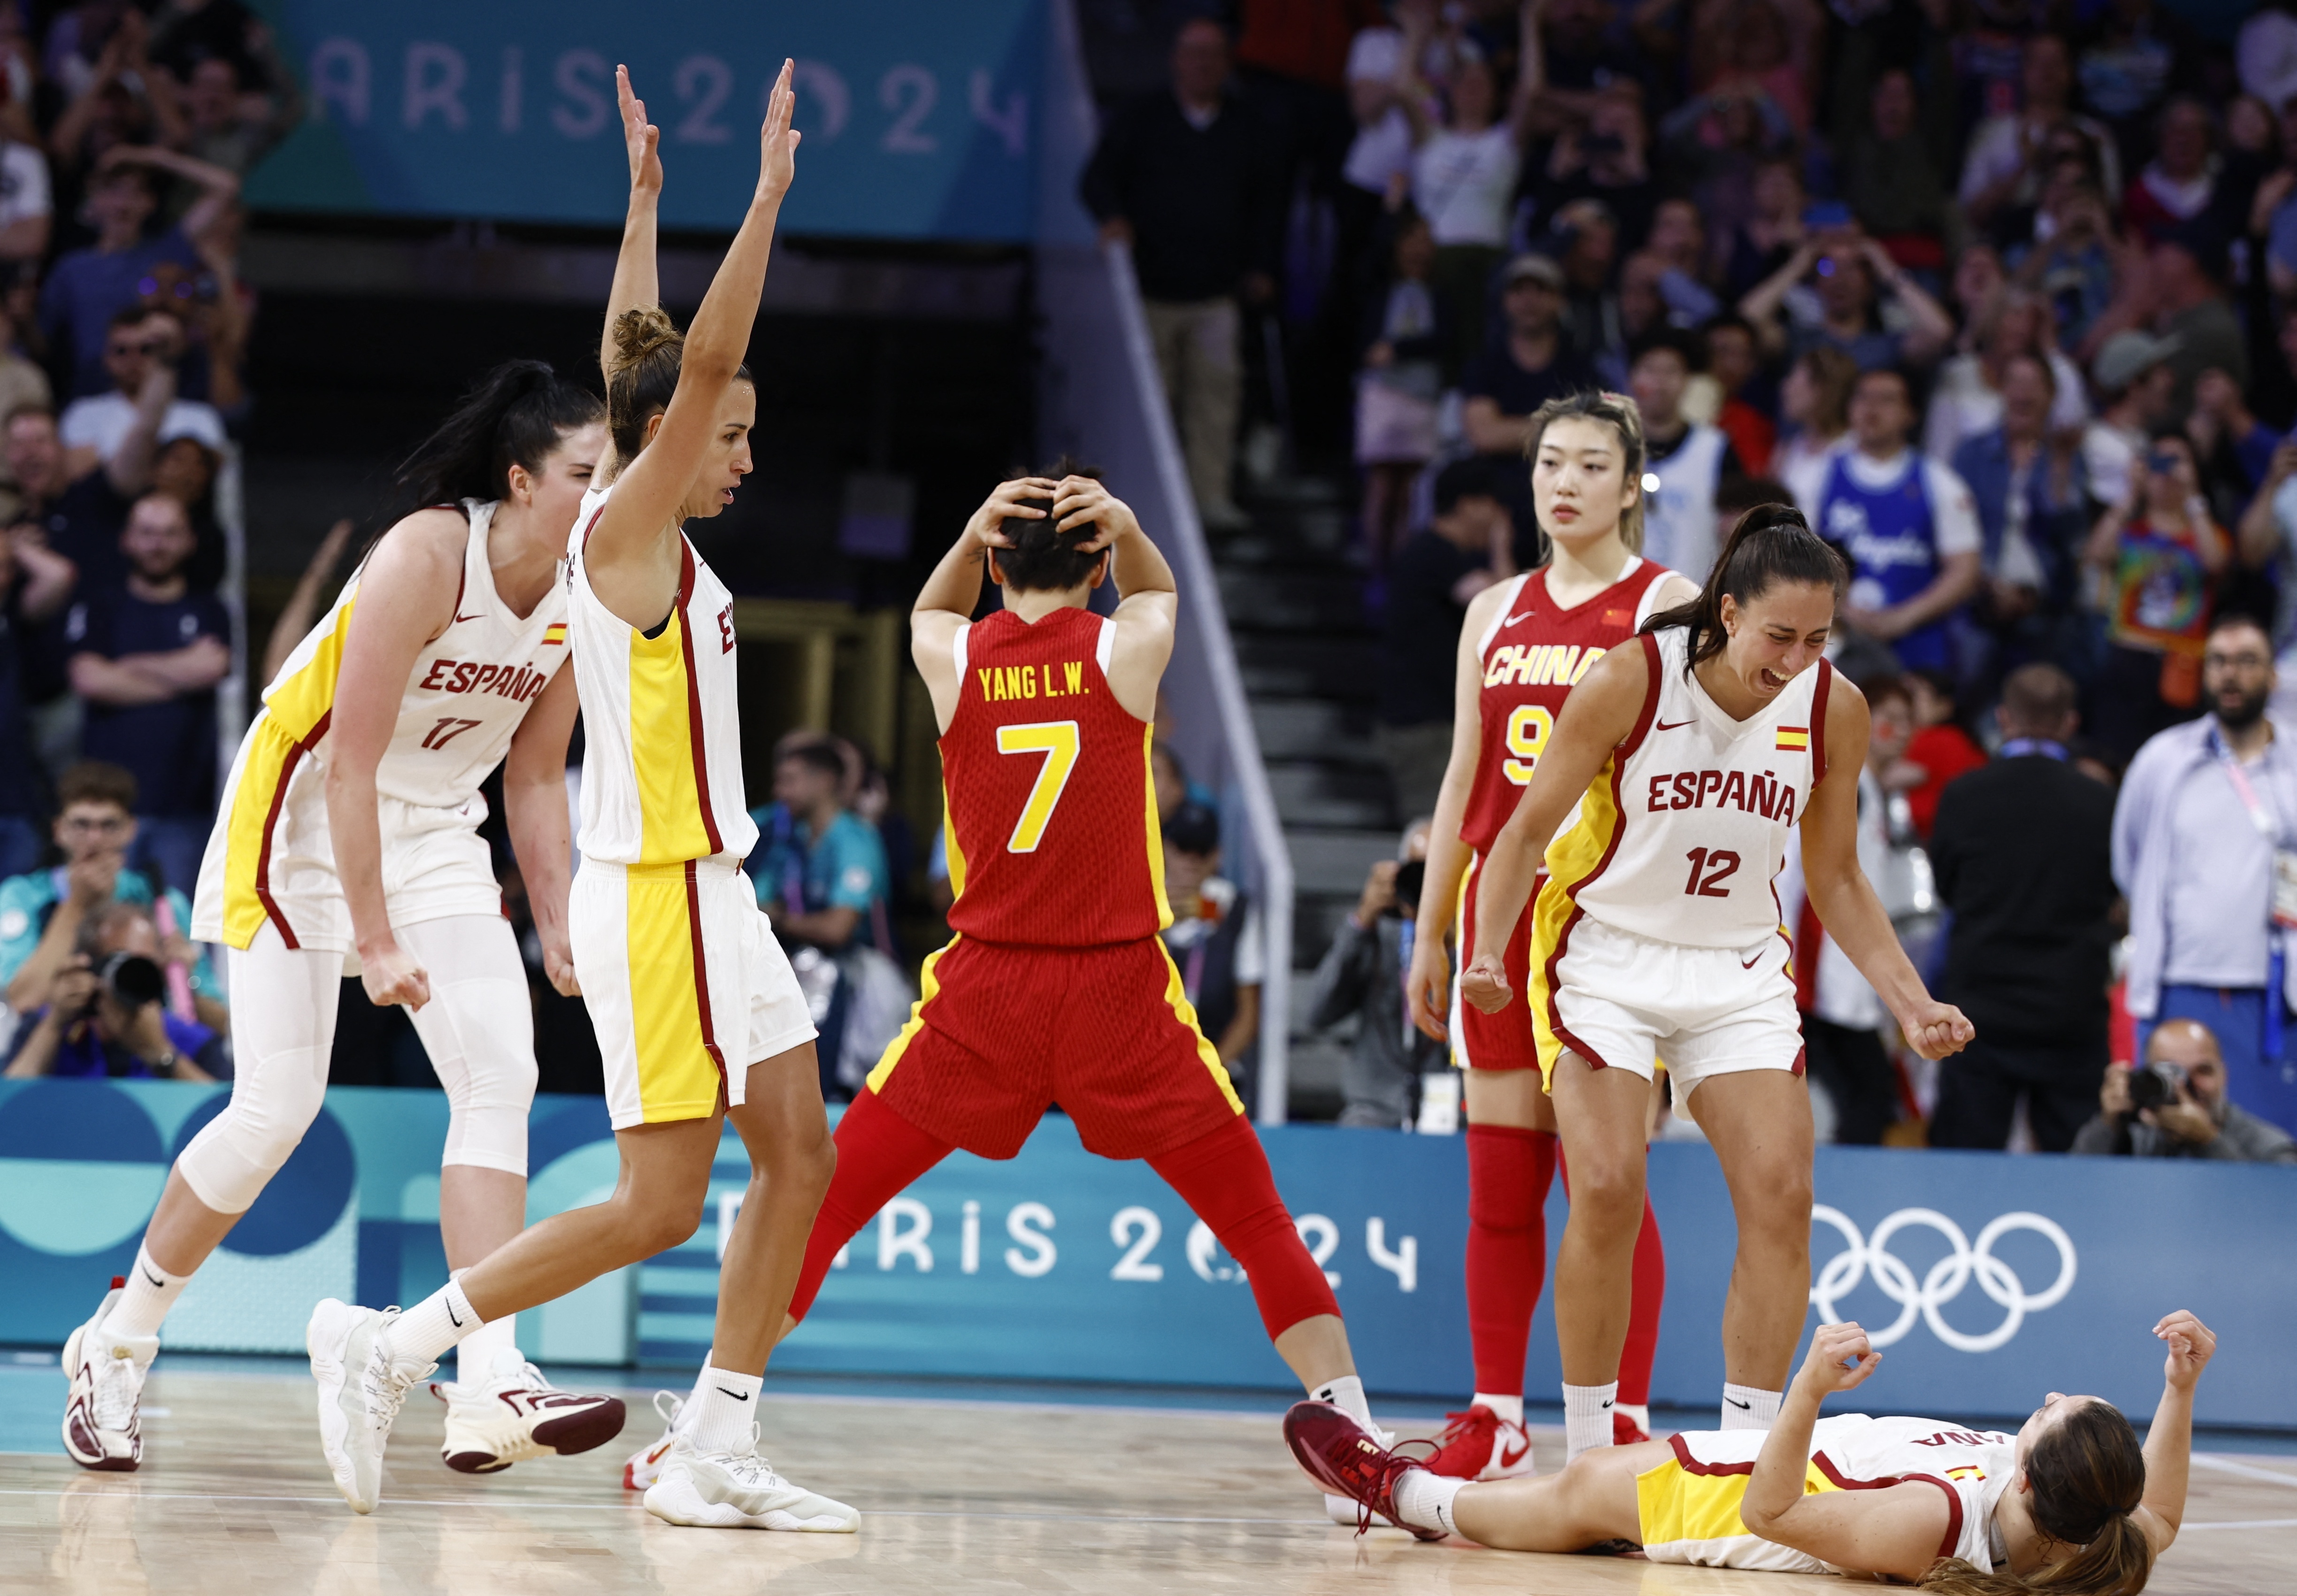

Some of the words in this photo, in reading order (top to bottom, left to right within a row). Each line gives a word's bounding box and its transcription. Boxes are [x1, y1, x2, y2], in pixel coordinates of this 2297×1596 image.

[419, 659, 546, 703] ESPAÑA
[977, 665, 1037, 702] YANG
[1043, 661, 1091, 698] L.W.
[421, 717, 484, 751] 17
[1503, 704, 1555, 786] 9
[996, 720, 1081, 854] 7
[1648, 769, 1796, 828] ESPAÑA
[1684, 846, 1741, 898] 12
